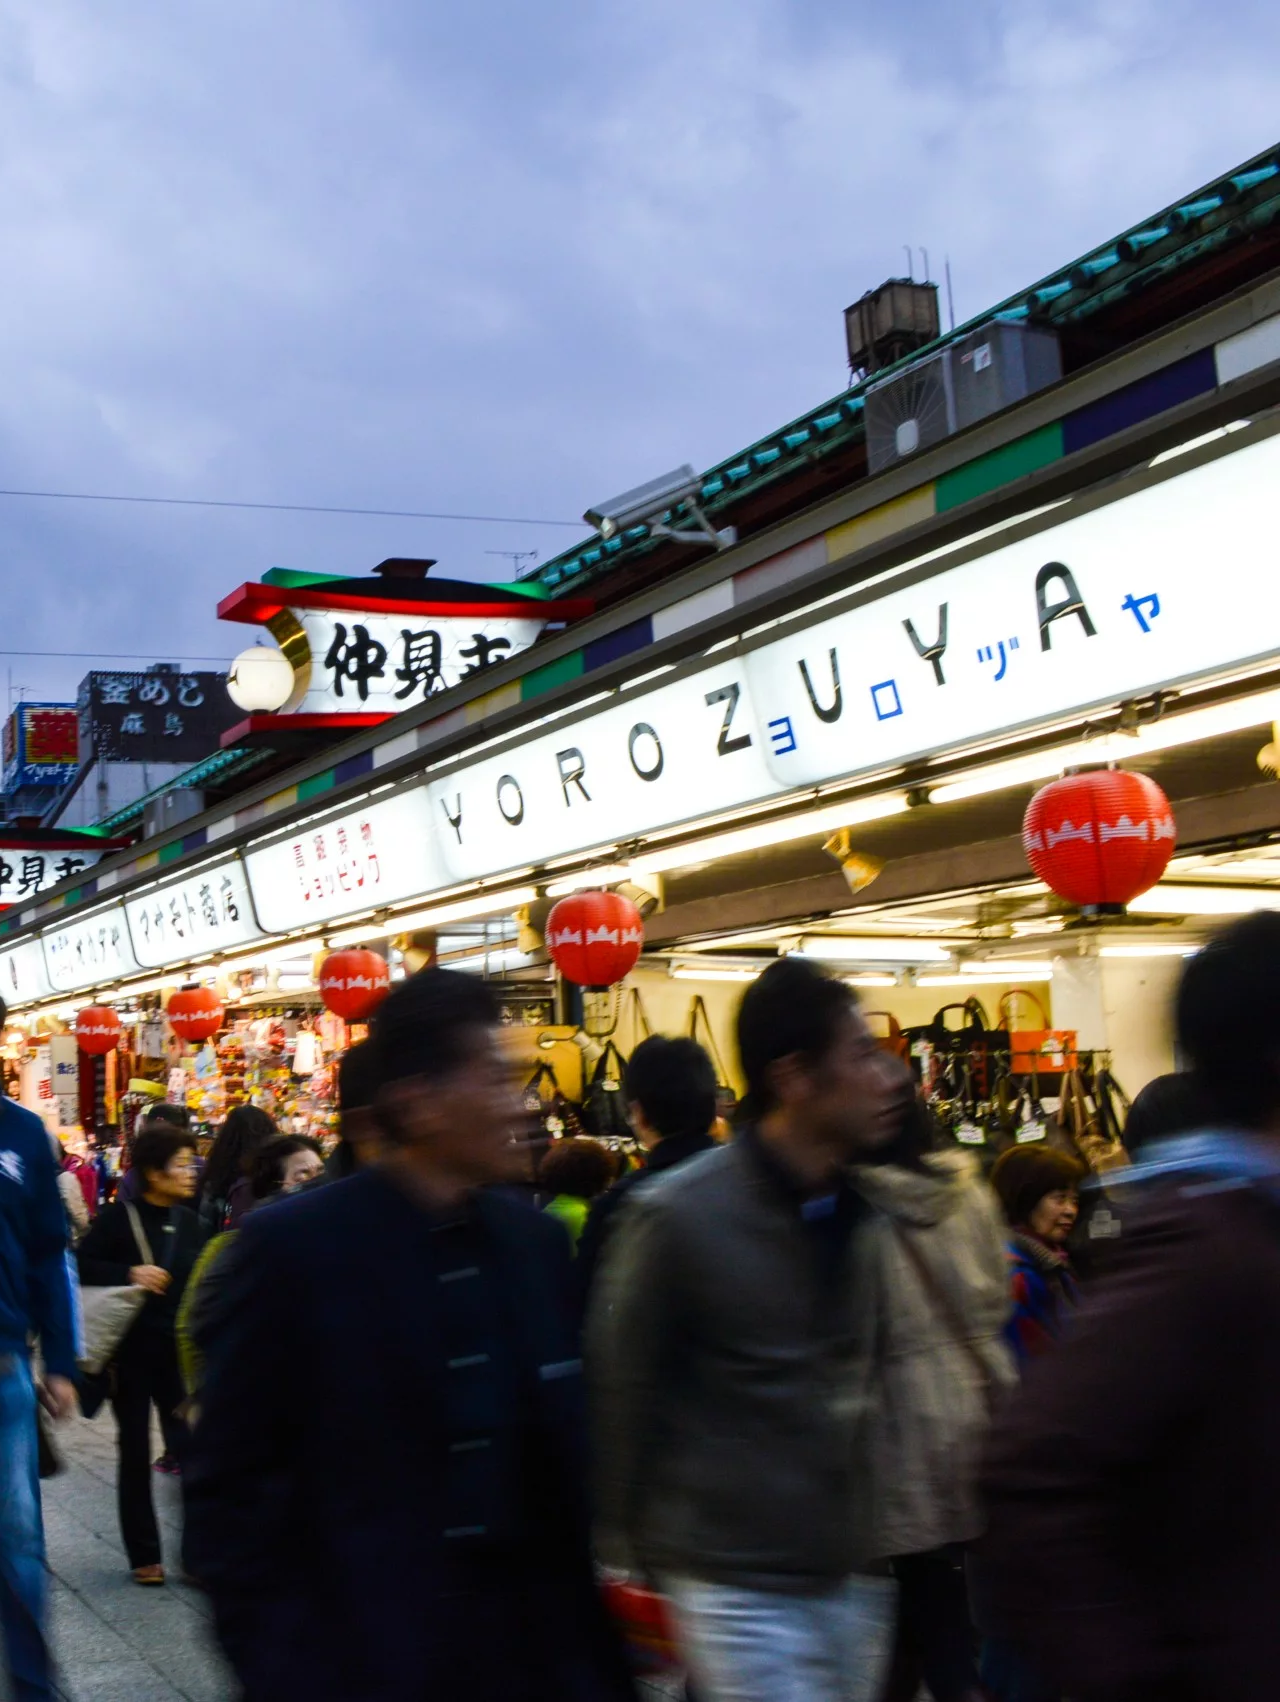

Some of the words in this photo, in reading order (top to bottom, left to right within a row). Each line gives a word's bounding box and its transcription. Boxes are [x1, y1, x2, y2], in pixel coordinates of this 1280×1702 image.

[440, 561, 1098, 845] YOROZUYA
[767, 592, 1161, 756] ヨロヅヤ
